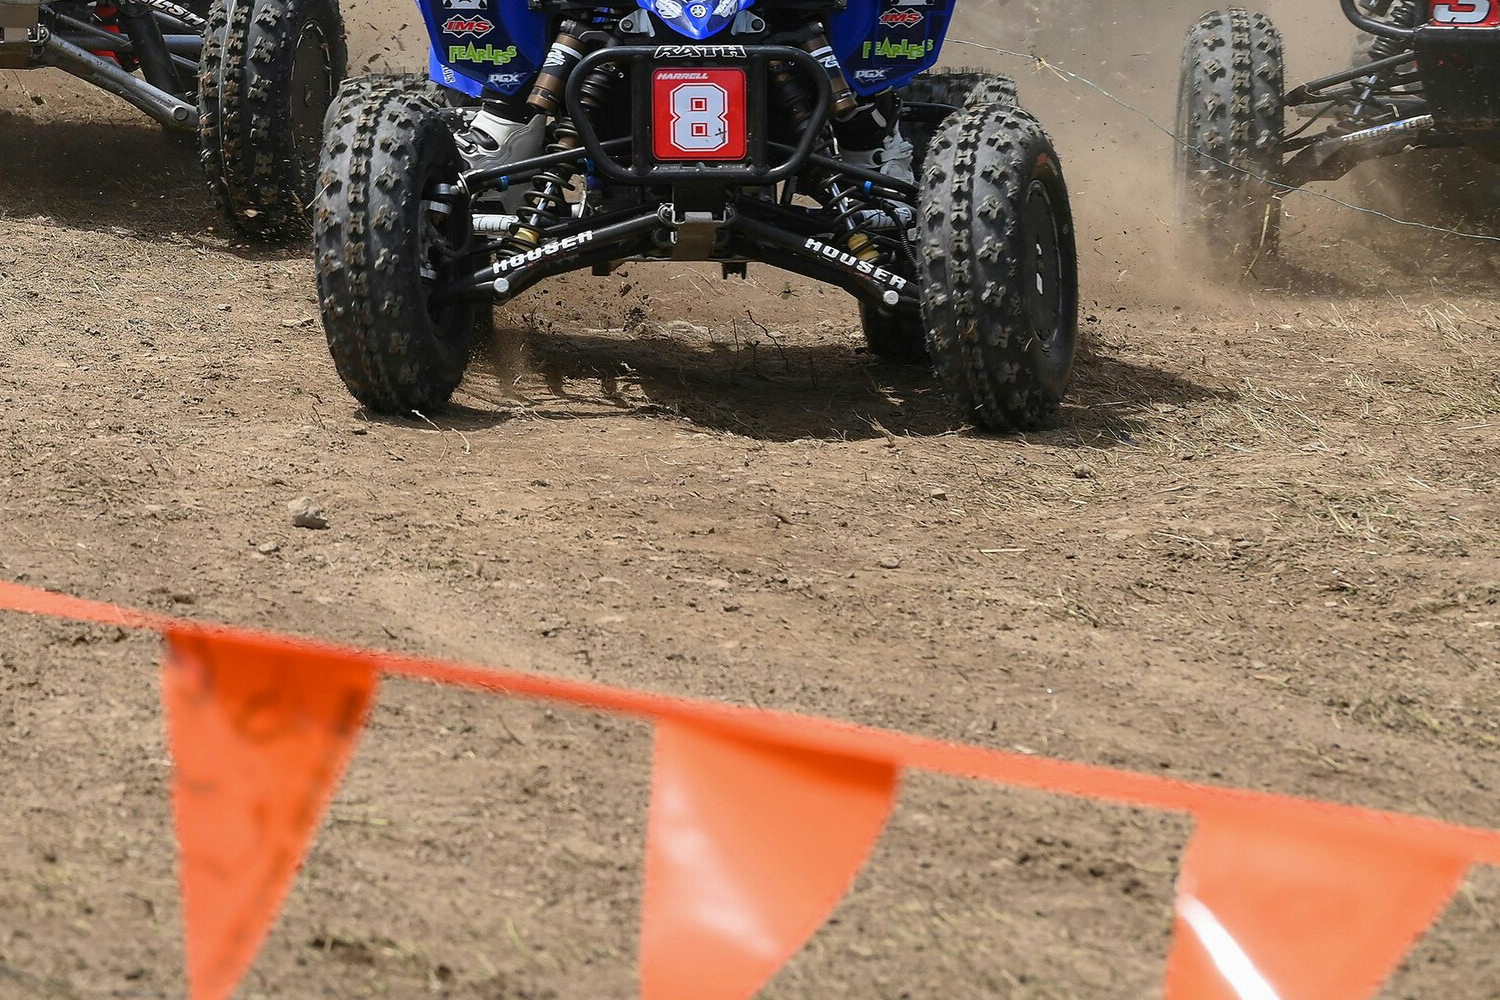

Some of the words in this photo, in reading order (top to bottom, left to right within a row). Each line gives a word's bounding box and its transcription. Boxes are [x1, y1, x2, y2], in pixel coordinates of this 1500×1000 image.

[445, 19, 491, 32] IMS
[883, 13, 920, 23] IMS
[654, 44, 747, 59] RATH
[657, 72, 709, 80] HARRELL
[670, 82, 729, 152] 8
[492, 230, 595, 275] HOUSER
[803, 237, 908, 291] HOUSER
